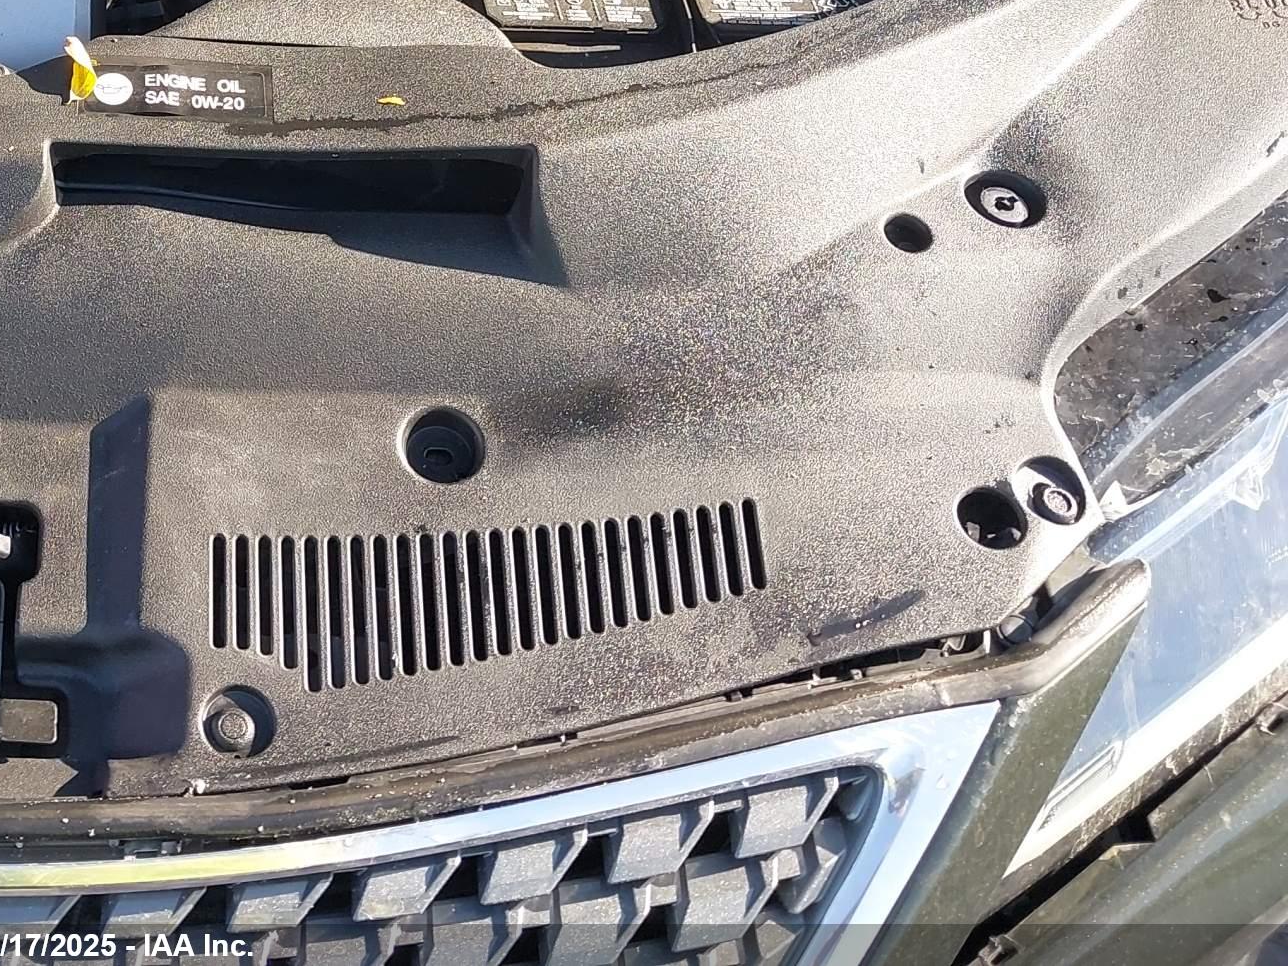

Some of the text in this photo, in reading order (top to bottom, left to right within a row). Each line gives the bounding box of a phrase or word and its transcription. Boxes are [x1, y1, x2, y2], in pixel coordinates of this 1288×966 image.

[144, 73, 246, 94] ENGINE OIL
[144, 90, 245, 111] SAE 0W-20
